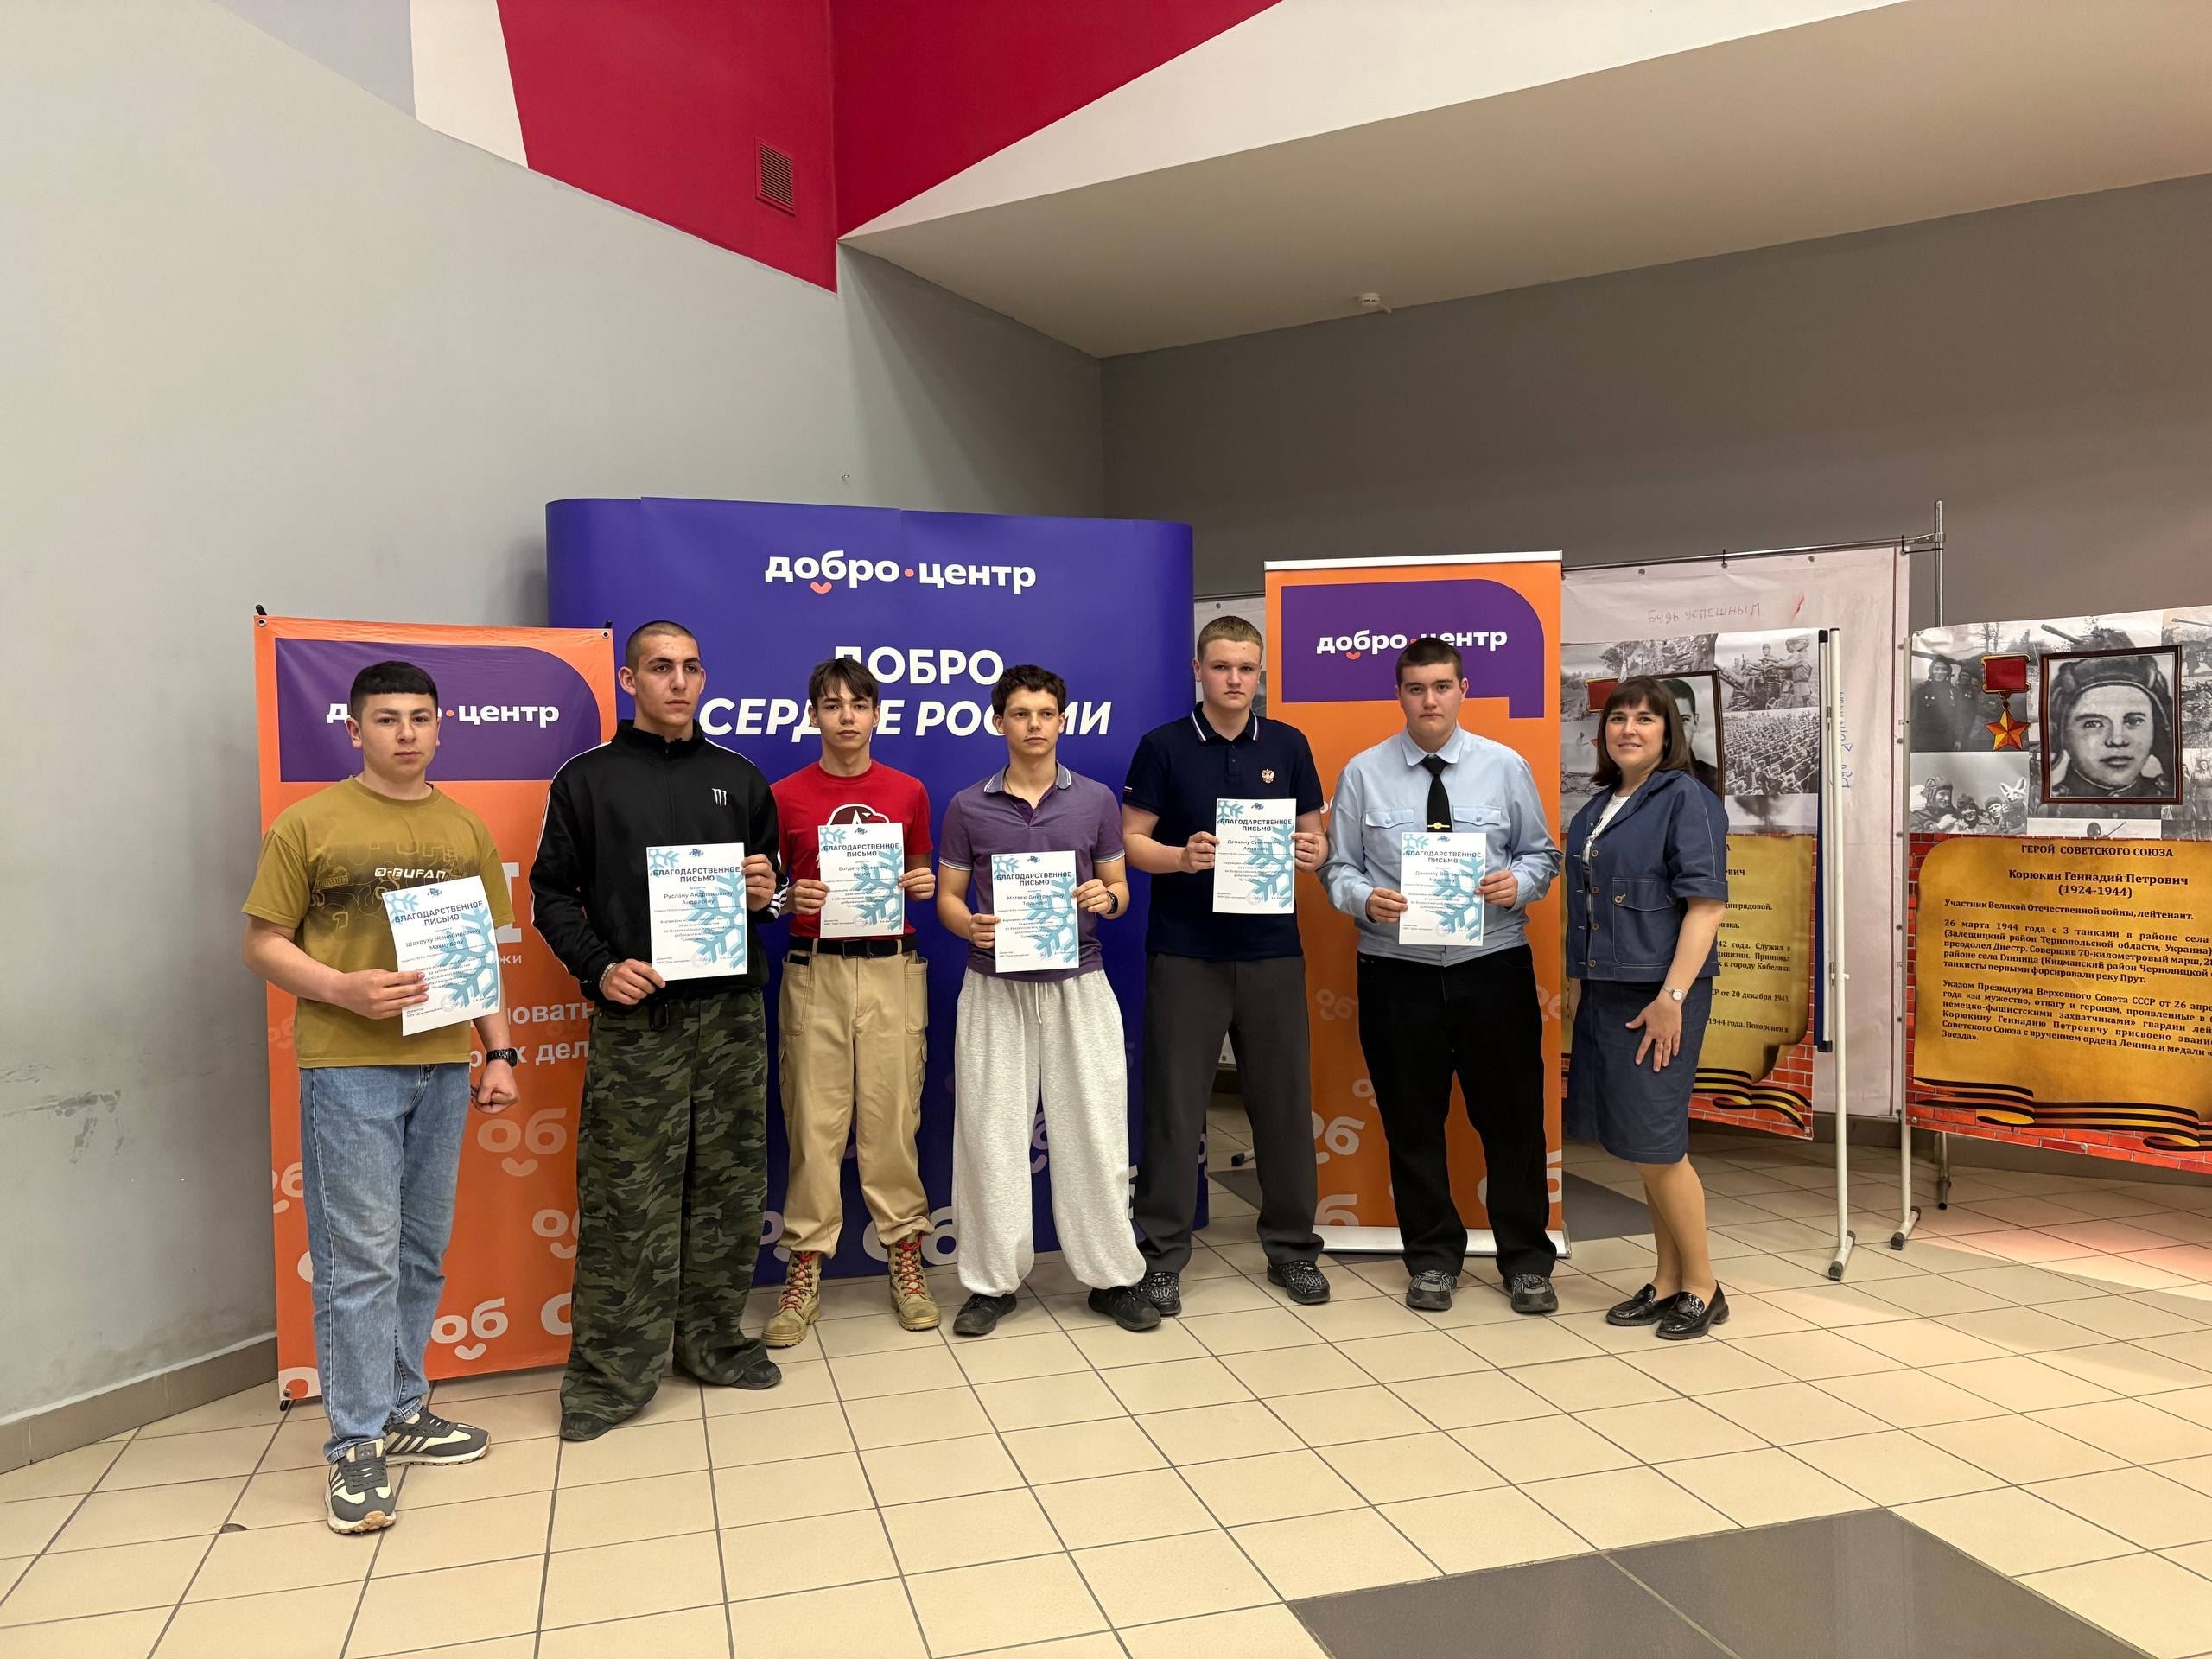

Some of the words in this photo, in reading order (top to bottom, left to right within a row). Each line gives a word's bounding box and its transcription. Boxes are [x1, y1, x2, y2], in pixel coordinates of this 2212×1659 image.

[823, 842, 899, 852] БЛАГОДАРСТВЕННОЕ
[2021, 844, 2056, 855] ГЕРОЙ
[2060, 846, 2131, 856] СОВЕТСКОГО
[2133, 848, 2174, 857] СОЮЗА
[652, 866, 741, 877] БЛАГОДАРСТВЕННОЕ
[680, 874, 715, 883] ПИСЬМО
[996, 871, 1072, 880] БЛАГОДАРСТВЕННОЕ
[2008, 869, 2062, 881] Корюкин
[2064, 872, 2123, 883] Геннадий
[2126, 874, 2189, 887] Петрович
[2057, 884, 2133, 899] (1924-1944)
[394, 900, 485, 924] БЛАГОДАРСТВЕННОЕ
[1944, 899, 1987, 909] Участник
[1987, 901, 2026, 912] Великой
[2027, 904, 2100, 916] Отечественной
[2101, 908, 2136, 918] войны,
[2137, 911, 2194, 921] лейтенант.
[423, 913, 460, 927] ПИСЬМО
[1944, 918, 1956, 927] 26
[1961, 921, 1990, 931] марта
[1996, 922, 2018, 931] 1944
[2024, 925, 2046, 934] года
[2075, 929, 2120, 938] танками
[2139, 932, 2178, 942] районе
[1755, 942, 1783, 952] Служил
[1943, 929, 2005, 941] (Залещицкий
[2009, 933, 2037, 944] район
[2040, 936, 2113, 949] Тернопольской
[2118, 941, 2161, 952] области,
[2164, 944, 2212, 957] Украина)
[1755, 952, 1791, 962] Принимал
[1943, 940, 1992, 951] преодолел
[1993, 943, 2028, 954] Днестр.
[2029, 945, 2076, 957] Совершив
[2078, 949, 2169, 963] 70-километровый
[2171, 957, 2202, 967] марш,
[1730, 962, 1756, 971] городу
[1943, 950, 1976, 959] районе
[1978, 952, 1998, 961] села
[1999, 954, 2038, 964] Глиница
[2040, 957, 2105, 969] (Кицманский
[2107, 963, 2137, 972] район
[2139, 964, 2209, 977] Черновицкой
[1943, 960, 1987, 970] танкисты
[1987, 963, 2030, 974] первыми
[2031, 965, 2094, 979] форсировали
[2095, 973, 2119, 982] реку
[2120, 974, 2146, 984] Прут.
[1742, 992, 1773, 1002] декабря
[1774, 995, 1789, 1003] 1943
[1942, 979, 1974, 989] Указом
[1977, 982, 2034, 995] Президиума
[2037, 988, 2092, 1001] Верховного
[2094, 993, 2128, 1003] Совета
[2132, 996, 2156, 1006] СССР
[1942, 990, 1962, 999] года
[1984, 995, 2031, 1007] мужество,
[2034, 999, 2066, 1009] отвагу
[2080, 1004, 2122, 1015] героизм,
[2126, 1008, 2196, 1021] проявленные
[1942, 1001, 2053, 1018] немецко-фашистскими
[2058, 1011, 2136, 1027] захватчиками»
[2143, 1020, 2186, 1032] гвардии
[1745, 1021, 1784, 1033] Похоронен
[1942, 1009, 1992, 1023] Корюкину
[1998, 1015, 2047, 1027] Геннадию
[2052, 1020, 2109, 1035] Петровичу
[2114, 1028, 2172, 1041] присвоено
[1942, 1030, 1980, 1041] Звезда».
[1942, 1020, 1993, 1033] Советского
[1993, 1025, 2022, 1036] Союза
[2030, 1030, 2082, 1044] вручением
[2082, 1036, 2117, 1046] ордена
[2119, 1039, 2157, 1051] Ленина
[2167, 1046, 2205, 1056] медали
